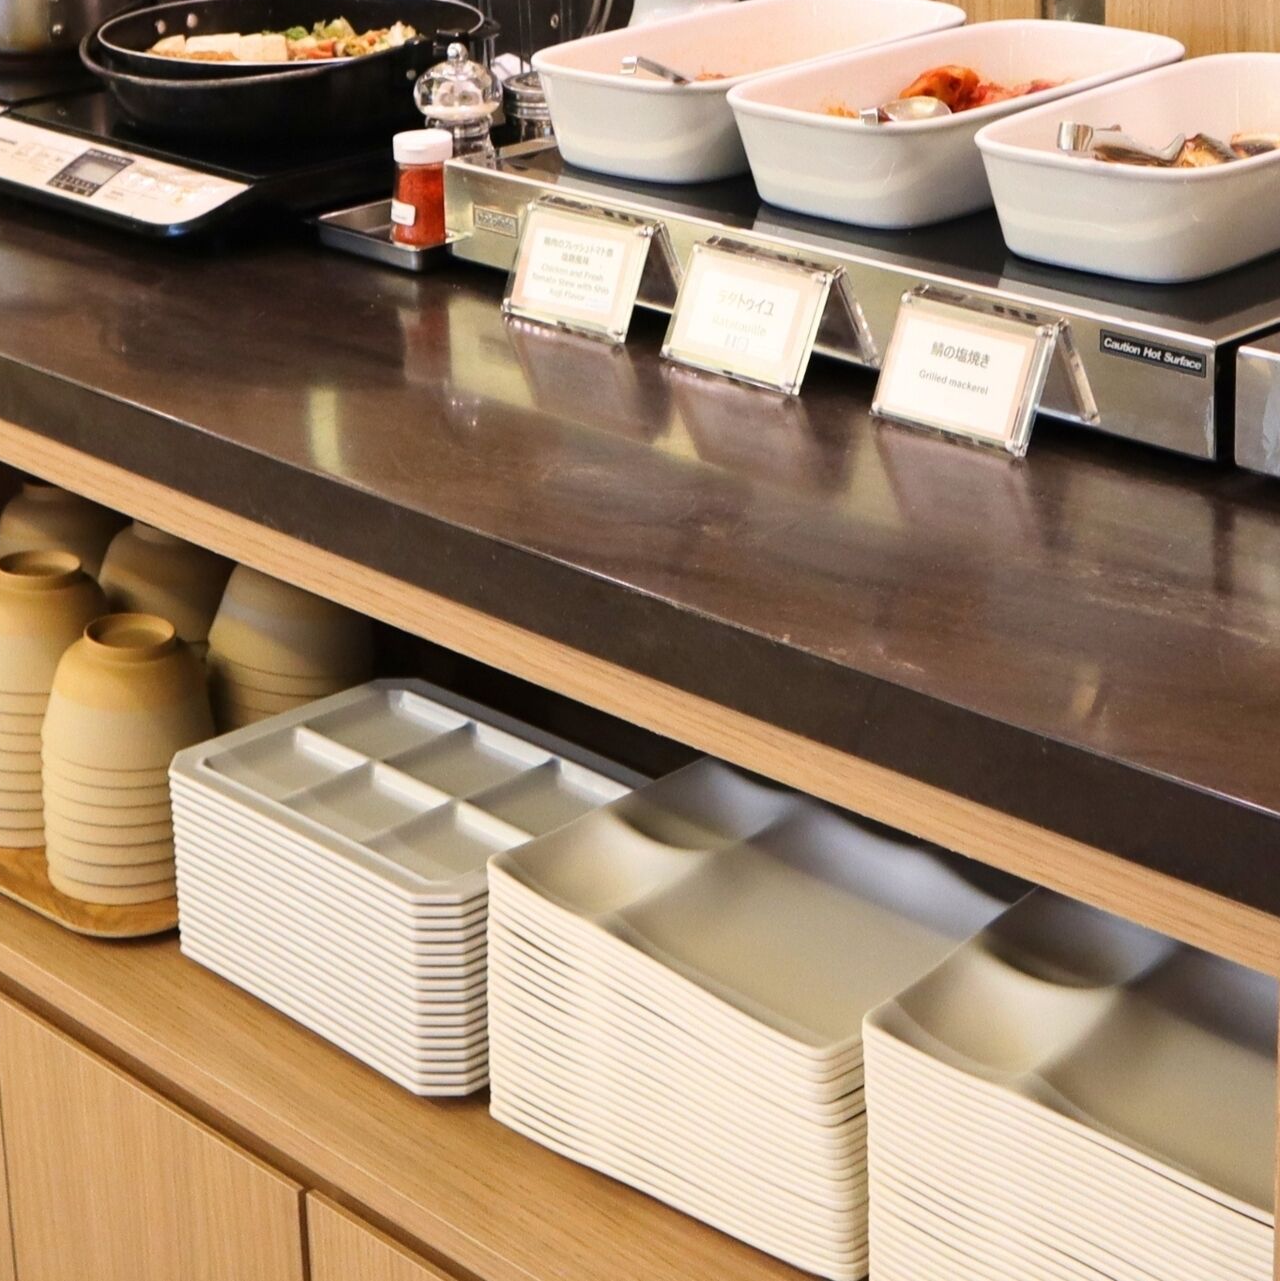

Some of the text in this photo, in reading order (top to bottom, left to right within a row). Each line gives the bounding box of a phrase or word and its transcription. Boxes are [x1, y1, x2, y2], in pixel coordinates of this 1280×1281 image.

[931, 340, 990, 369] 鯖の塩焼き
[1103, 337, 1202, 370] Caution Hot Surface
[918, 368, 989, 396] Grilled mackerel
